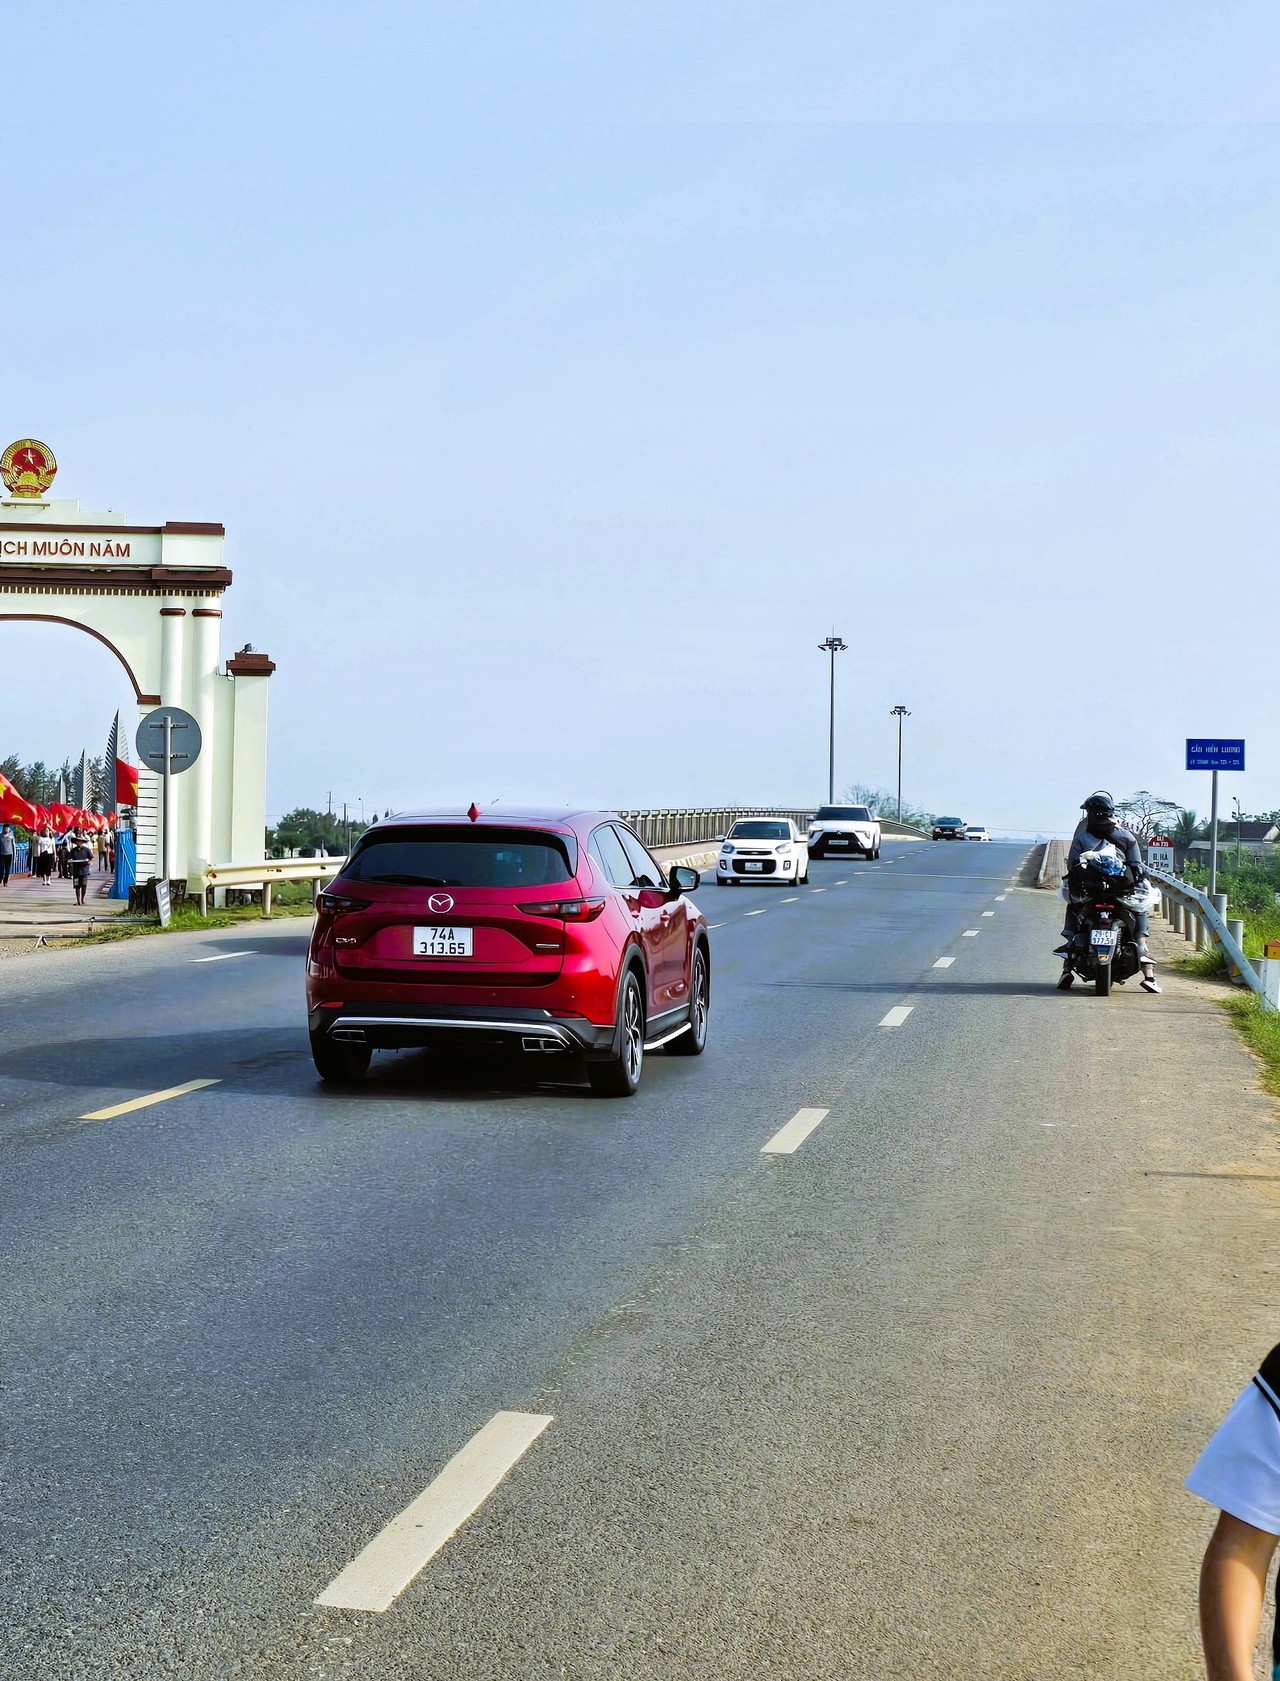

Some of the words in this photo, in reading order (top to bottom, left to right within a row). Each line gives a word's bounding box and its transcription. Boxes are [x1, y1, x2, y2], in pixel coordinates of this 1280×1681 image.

[33, 538, 85, 556] MUÔN
[90, 539, 131, 558] NĂM
[430, 928, 455, 941] 74A
[419, 942, 466, 955] 313.65
